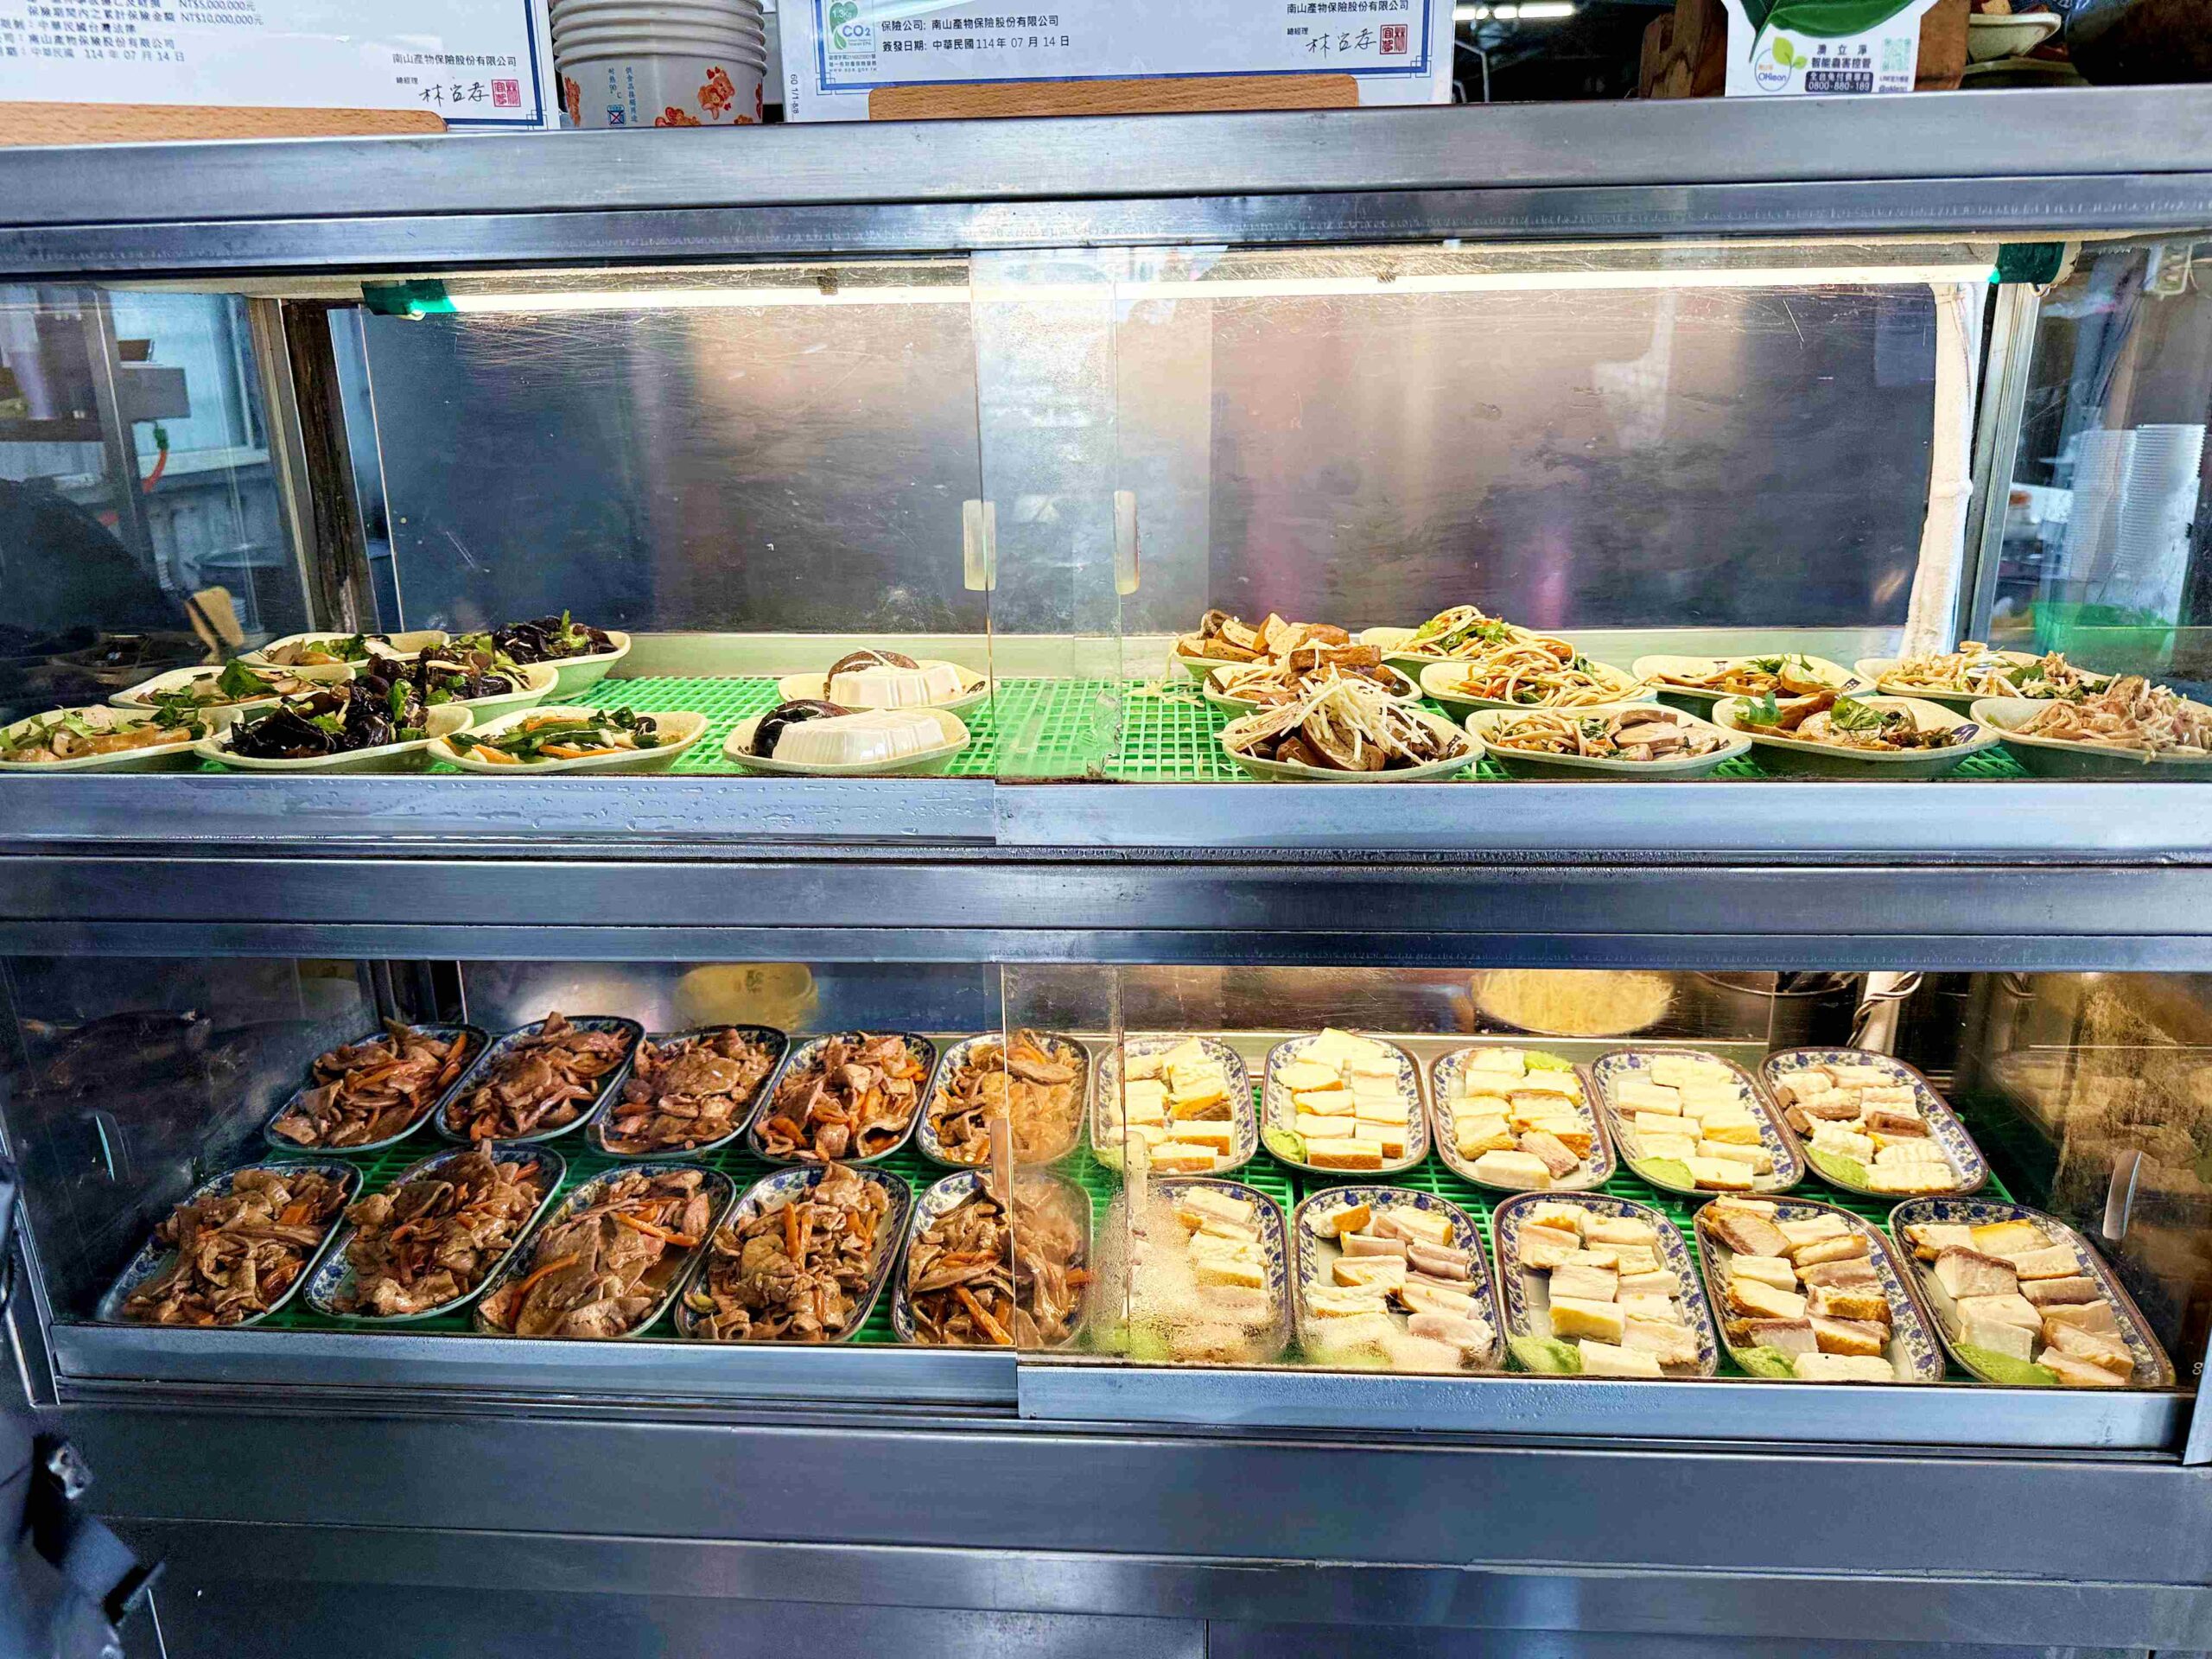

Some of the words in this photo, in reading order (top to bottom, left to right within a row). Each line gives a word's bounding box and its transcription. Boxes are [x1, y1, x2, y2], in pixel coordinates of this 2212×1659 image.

[1287, 0, 1408, 14] 南山產物保險股份有限公司
[931, 16, 1058, 30] 南山產物保險股份有限公司
[392, 54, 517, 67] 南山產物保險股份有限公司
